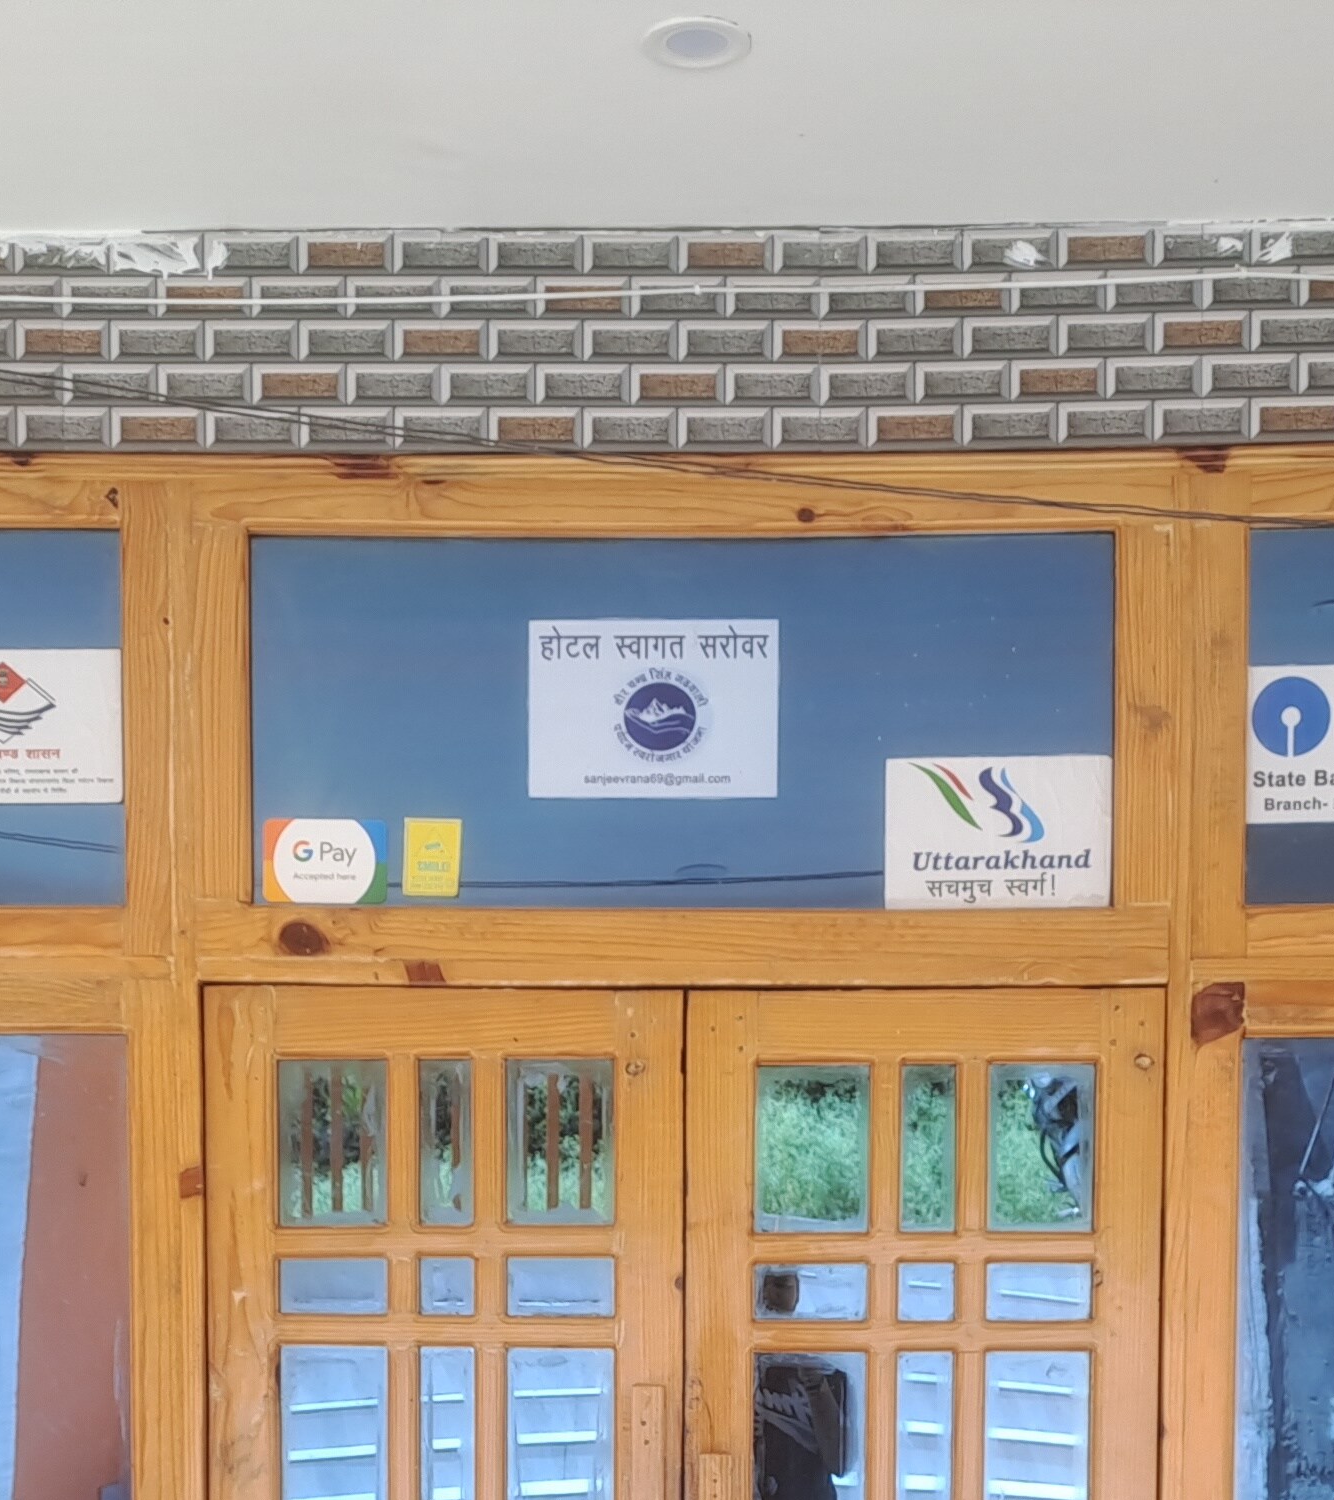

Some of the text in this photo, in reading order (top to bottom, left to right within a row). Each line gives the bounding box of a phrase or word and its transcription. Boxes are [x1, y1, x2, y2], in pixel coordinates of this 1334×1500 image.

[539, 625, 769, 661] होटल स्वागत सरोवर
[25, 749, 61, 760] शासन
[583, 773, 731, 786] sanjeevrana69@gmail.com
[1253, 770, 1306, 787] State
[1264, 797, 1328, 811] Branch-
[293, 840, 357, 867] G Pay
[912, 848, 1091, 871] Uttarakhand
[293, 871, 357, 882] Accepted here
[925, 872, 1057, 903] सचमुच स्वर्ग!
